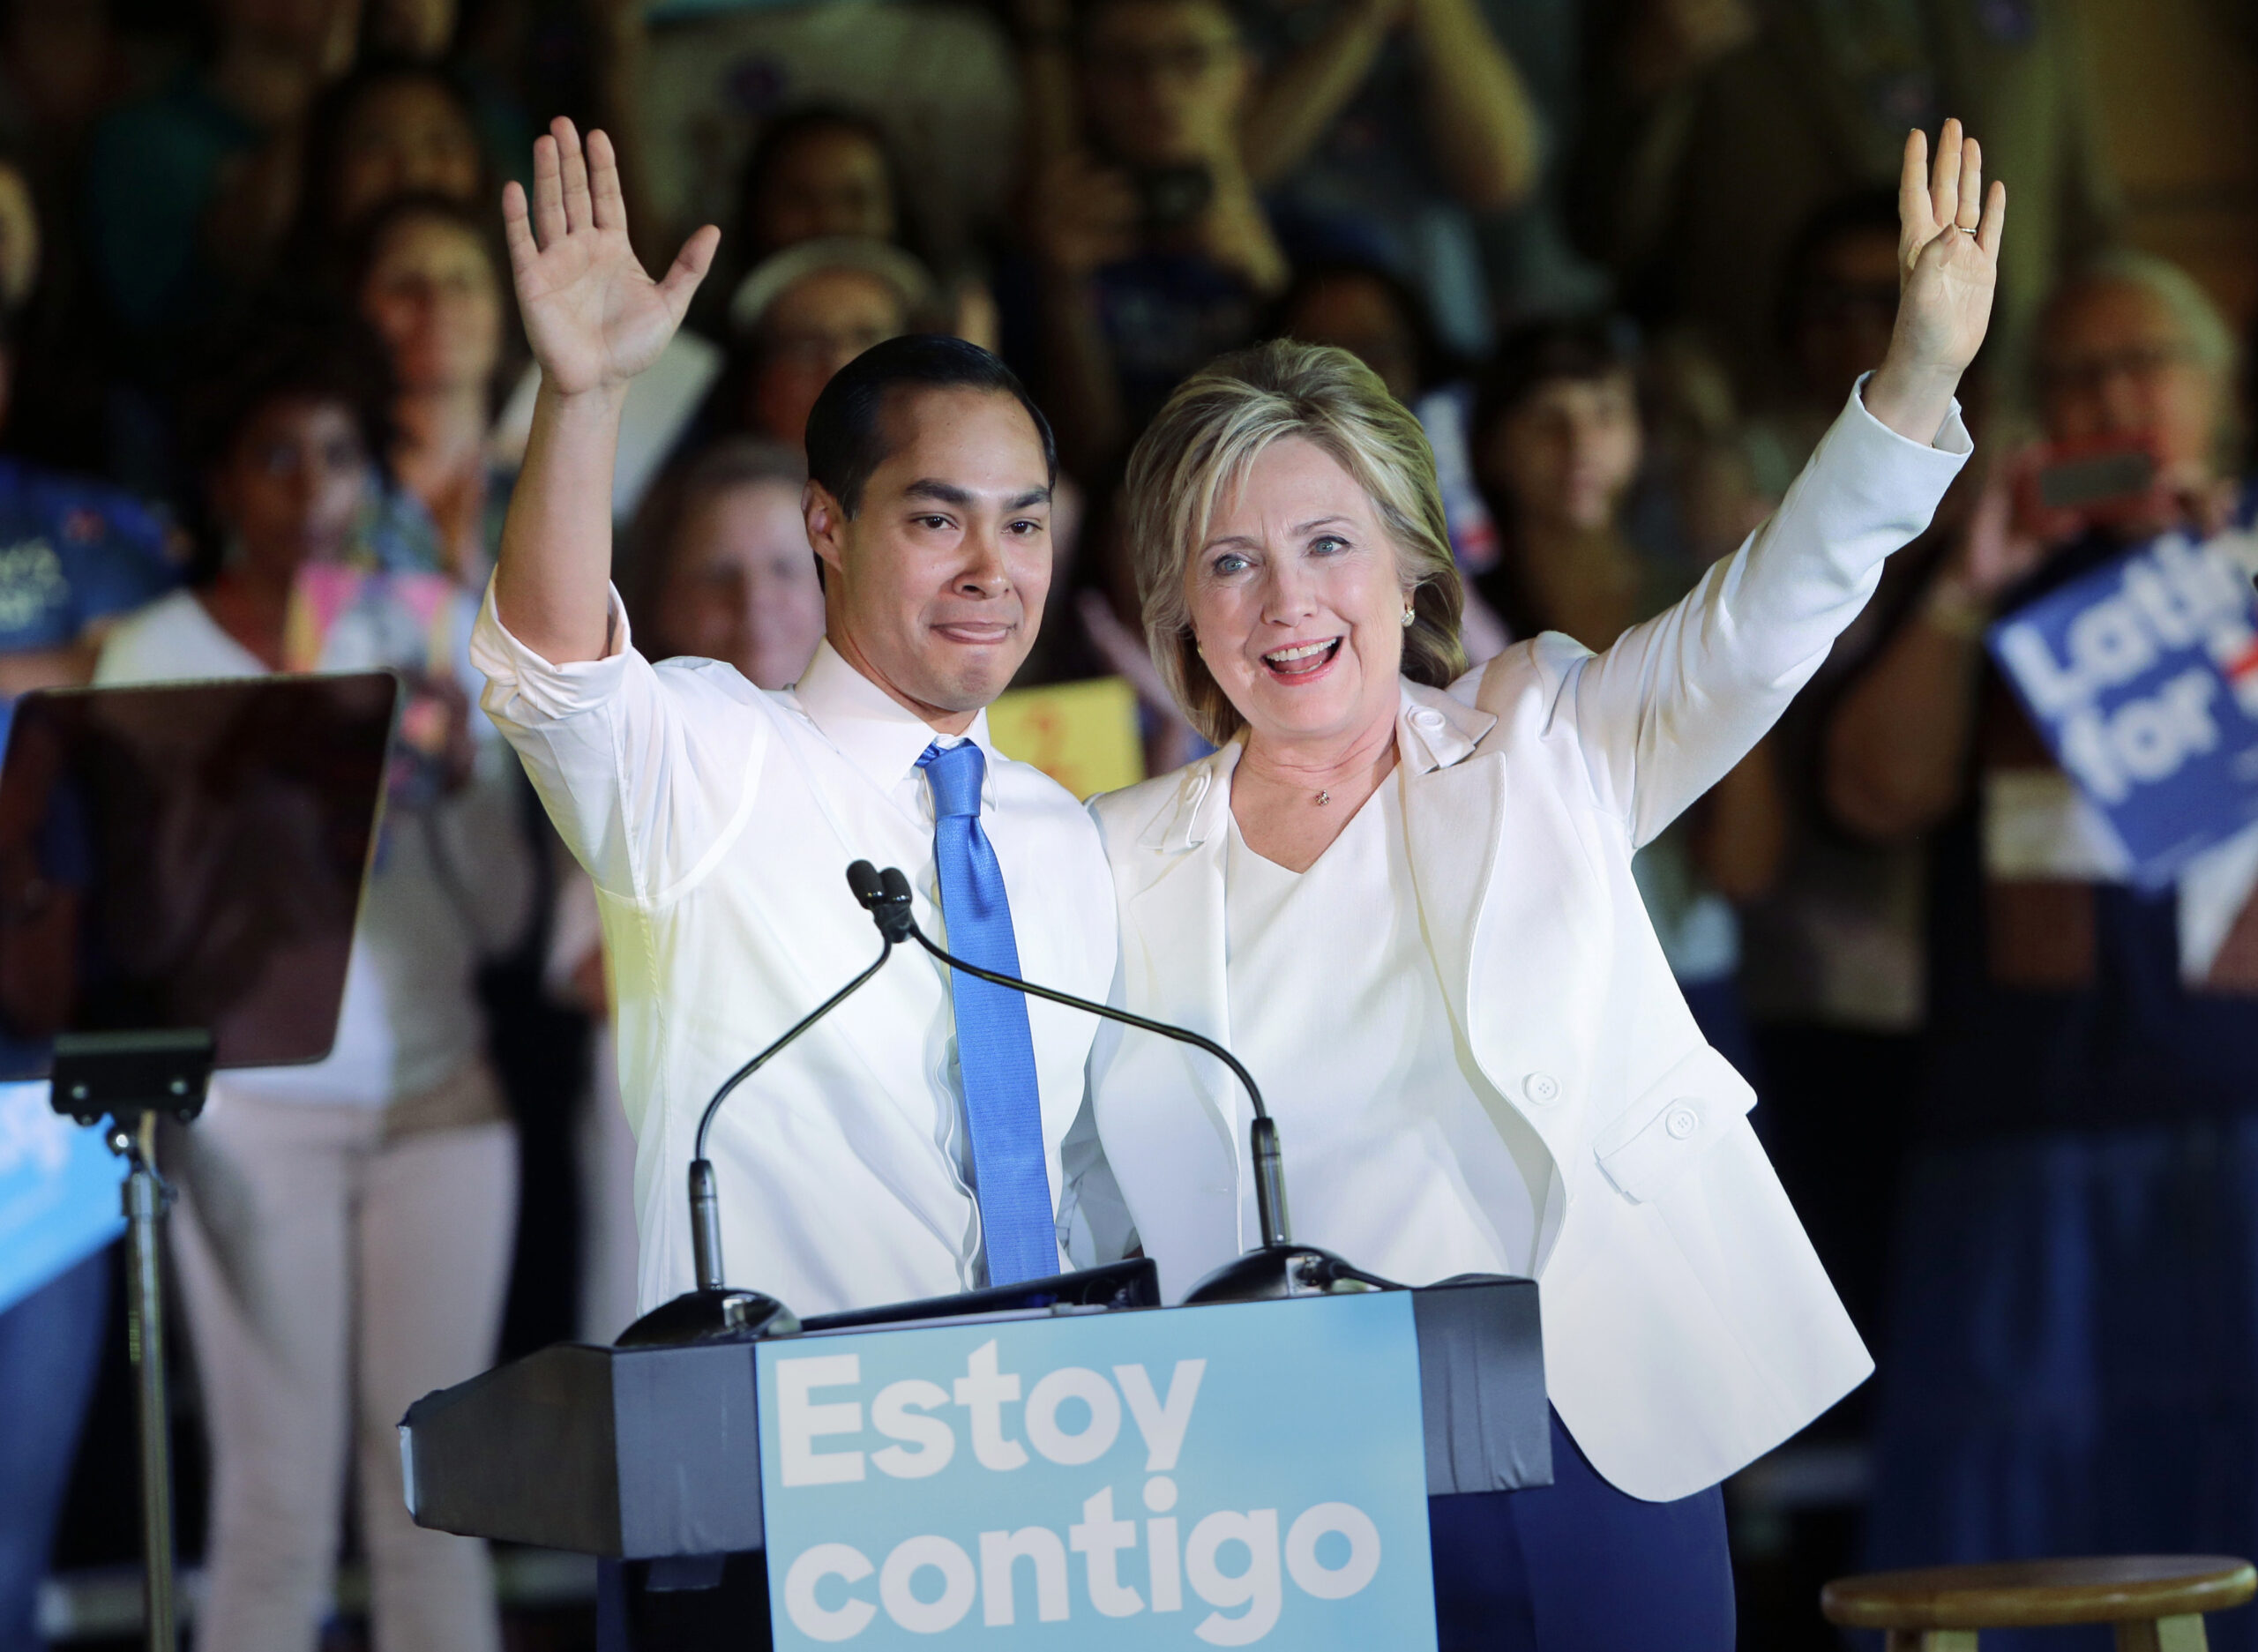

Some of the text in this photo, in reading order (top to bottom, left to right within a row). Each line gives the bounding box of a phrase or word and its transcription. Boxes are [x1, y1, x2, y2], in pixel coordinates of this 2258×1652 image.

[2060, 668, 2218, 804] for
[777, 1340, 1206, 1487] Estoy
[785, 1476, 1380, 1646] contigo
